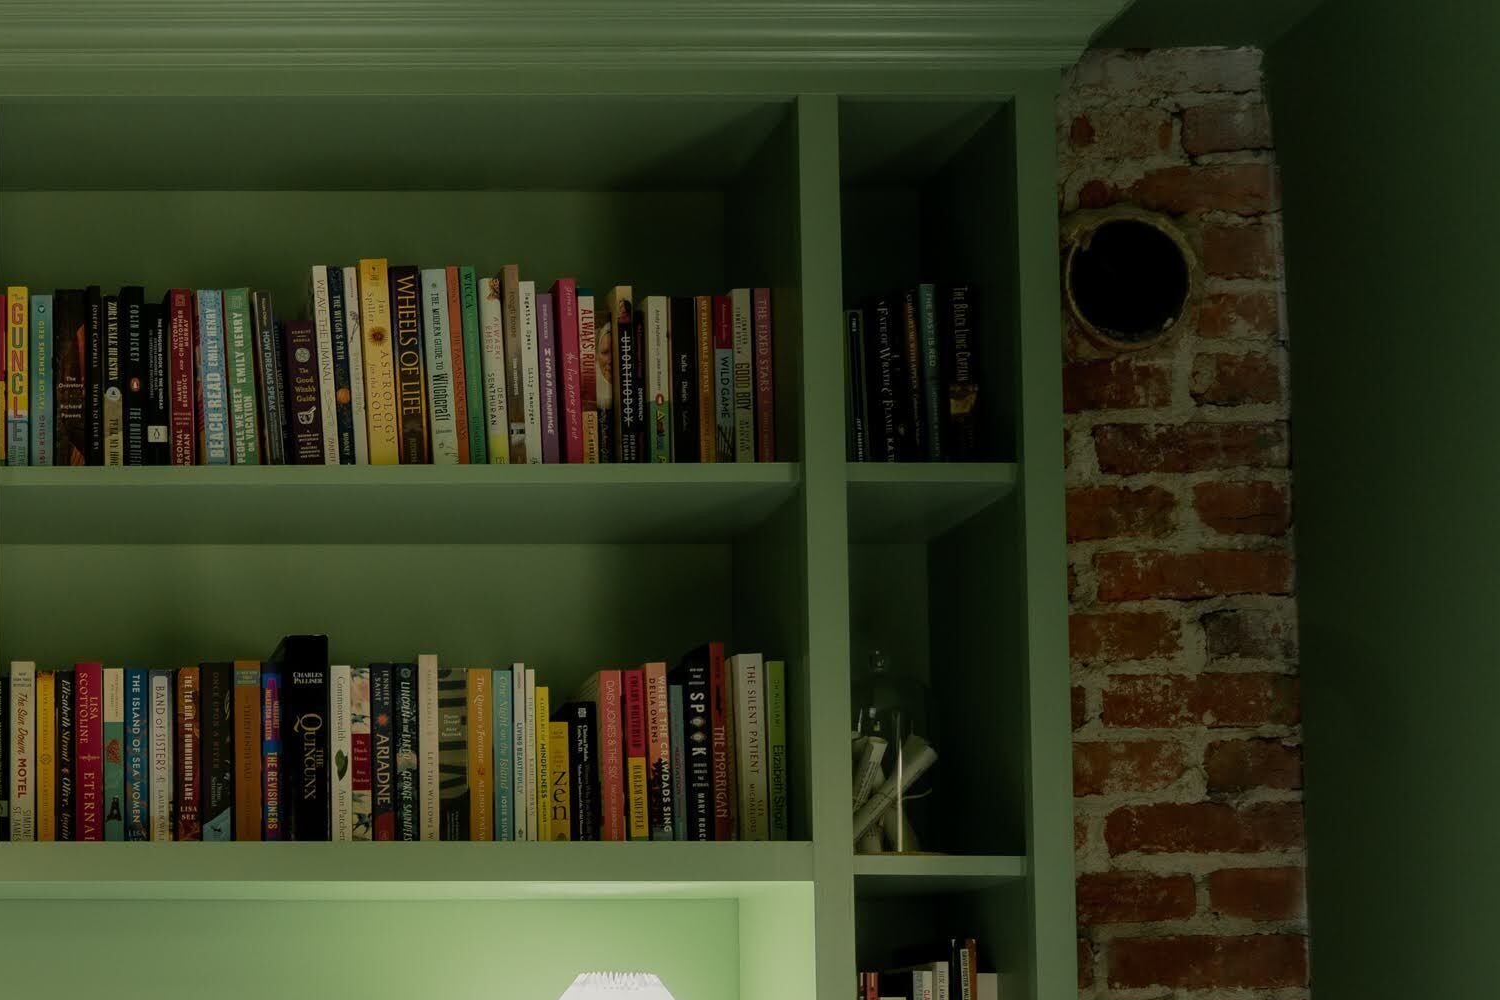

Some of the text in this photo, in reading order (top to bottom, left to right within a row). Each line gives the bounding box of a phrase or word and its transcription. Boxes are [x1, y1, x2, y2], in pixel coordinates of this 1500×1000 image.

[366, 292, 375, 323] Spiller
[464, 272, 473, 309] WICCA
[233, 312, 246, 383] EMILY HENRY
[396, 275, 420, 415] WHEELS OF LIFE
[757, 300, 769, 392] THE FIXED STARS
[926, 314, 934, 334] PAST
[928, 338, 934, 346] IS
[264, 353, 273, 384] DREAMS
[431, 294, 449, 421] THE MODERN GUIDE TO Witchcraft
[267, 387, 275, 411] SPEAK
[380, 351, 394, 445] ASTROLOGY
[487, 373, 496, 425] SENTHURAN
[720, 356, 730, 419] WILD GAME
[207, 373, 225, 458] BEACH READ
[80, 673, 88, 744] SCOTTOLINE
[90, 697, 98, 720] LISA
[132, 675, 140, 693] THE
[605, 680, 614, 706] DAISY
[132, 698, 140, 734] ISLAND
[184, 676, 193, 800] THE TEA GIRL OF HUMMINGBIRD LANE
[607, 709, 615, 737] JONES
[714, 726, 725, 747] THE
[747, 666, 758, 774] THE SILENT PATIENT
[132, 739, 140, 752] OF
[294, 713, 322, 799] QUINCUNX
[376, 734, 390, 806] ARIADNE
[516, 748, 524, 793] BEAUTIFULLY
[661, 743, 670, 802] CRAWDADS
[267, 752, 277, 829] THE REVISIONERS
[715, 752, 727, 818] MORRIGAN
[773, 745, 784, 829] Elizabeth Strout
[663, 806, 671, 832] SING
